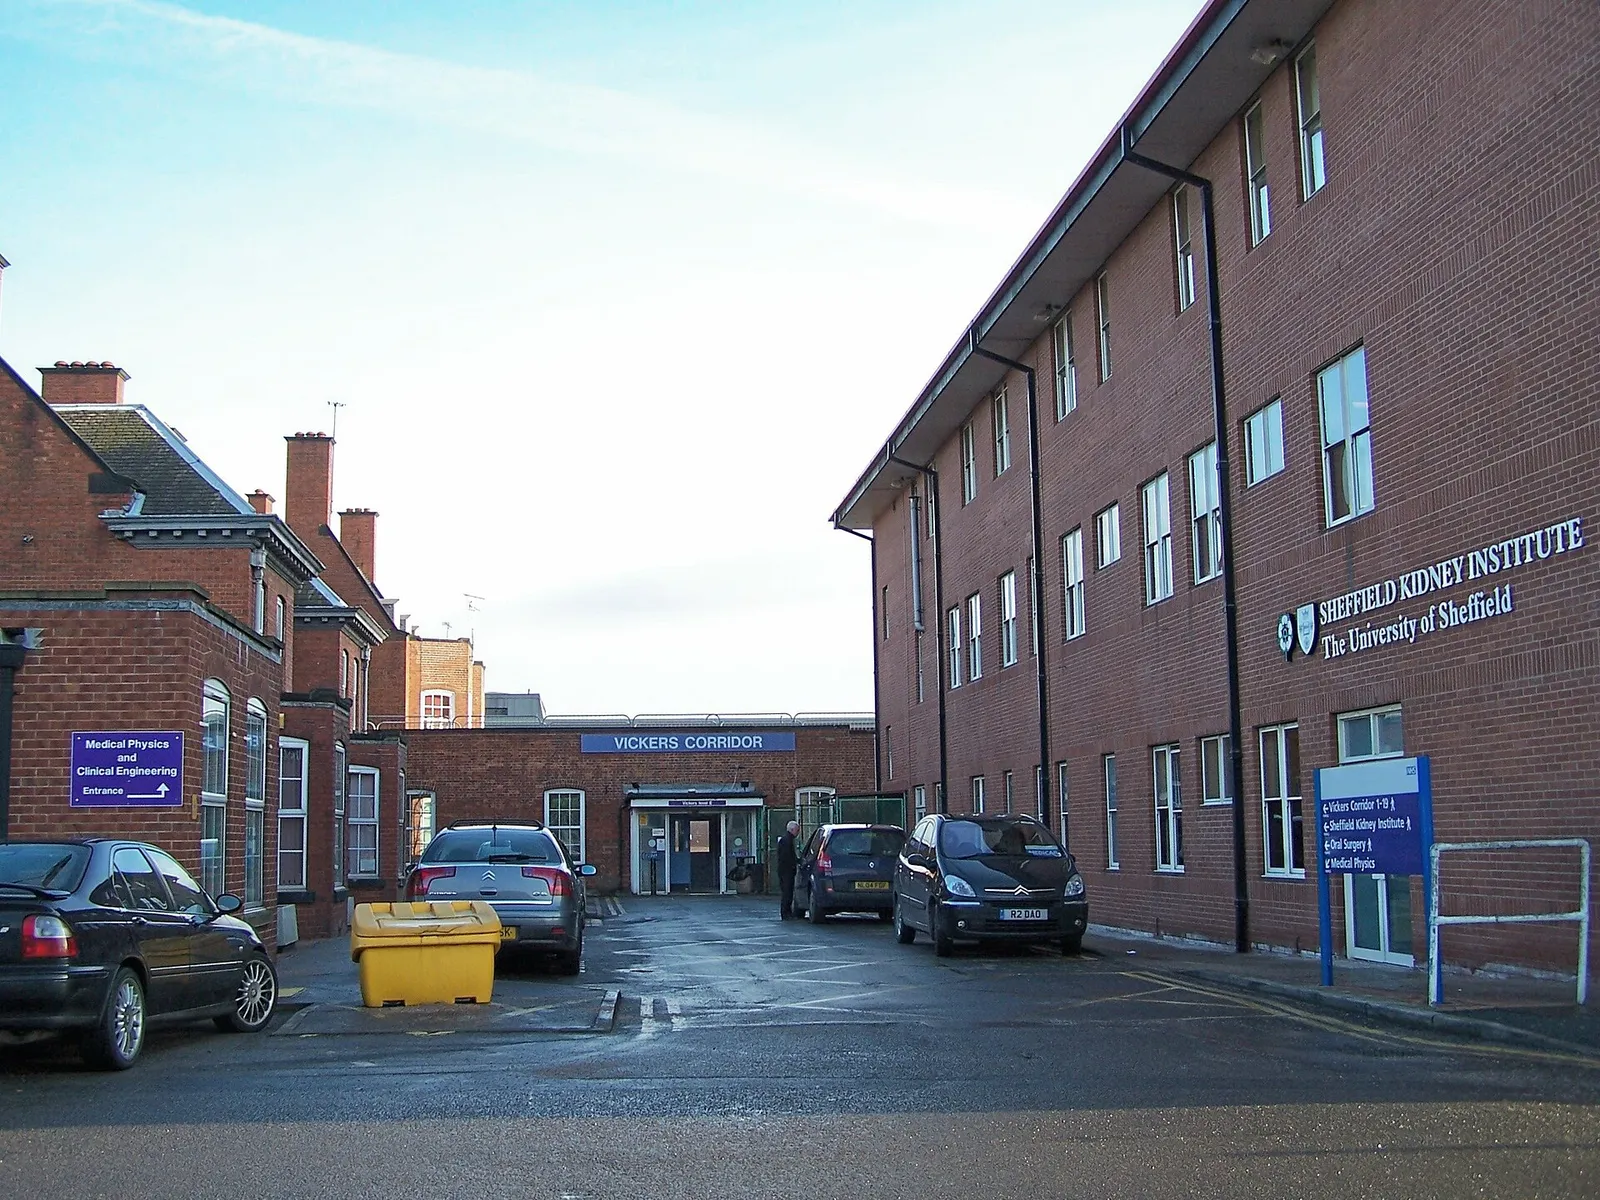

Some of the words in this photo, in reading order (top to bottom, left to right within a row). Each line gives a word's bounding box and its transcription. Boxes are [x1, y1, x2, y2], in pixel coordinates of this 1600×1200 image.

[1319, 579, 1397, 626] SHEFFIELD
[1400, 556, 1464, 601] KIDNEY
[1467, 517, 1583, 580] INSTITUTE
[1321, 633, 1346, 660] The
[1348, 614, 1417, 644] University
[1420, 605, 1436, 634] of
[1438, 583, 1513, 629] Sheffield
[85, 739, 126, 749] Medical
[128, 739, 170, 751] Physics
[613, 736, 679, 750] VICKERS
[684, 735, 763, 749] CORRIDOR
[117, 753, 137, 762] and
[76, 766, 114, 776] Clinical
[116, 766, 178, 777] Engineering
[83, 786, 124, 795] Entrance
[1328, 801, 1350, 813] Vickers
[1350, 799, 1375, 812] Corridor
[1329, 818, 1355, 832] Sheffield
[1355, 818, 1377, 833] Kidney
[1377, 816, 1405, 829] Institute
[1330, 838, 1343, 850] Oral
[1343, 838, 1366, 853] Surgery
[1330, 857, 1353, 869] Medical
[1353, 857, 1376, 872] Physics
[1010, 910, 1023, 919] R2
[499, 927, 512, 937] SK
